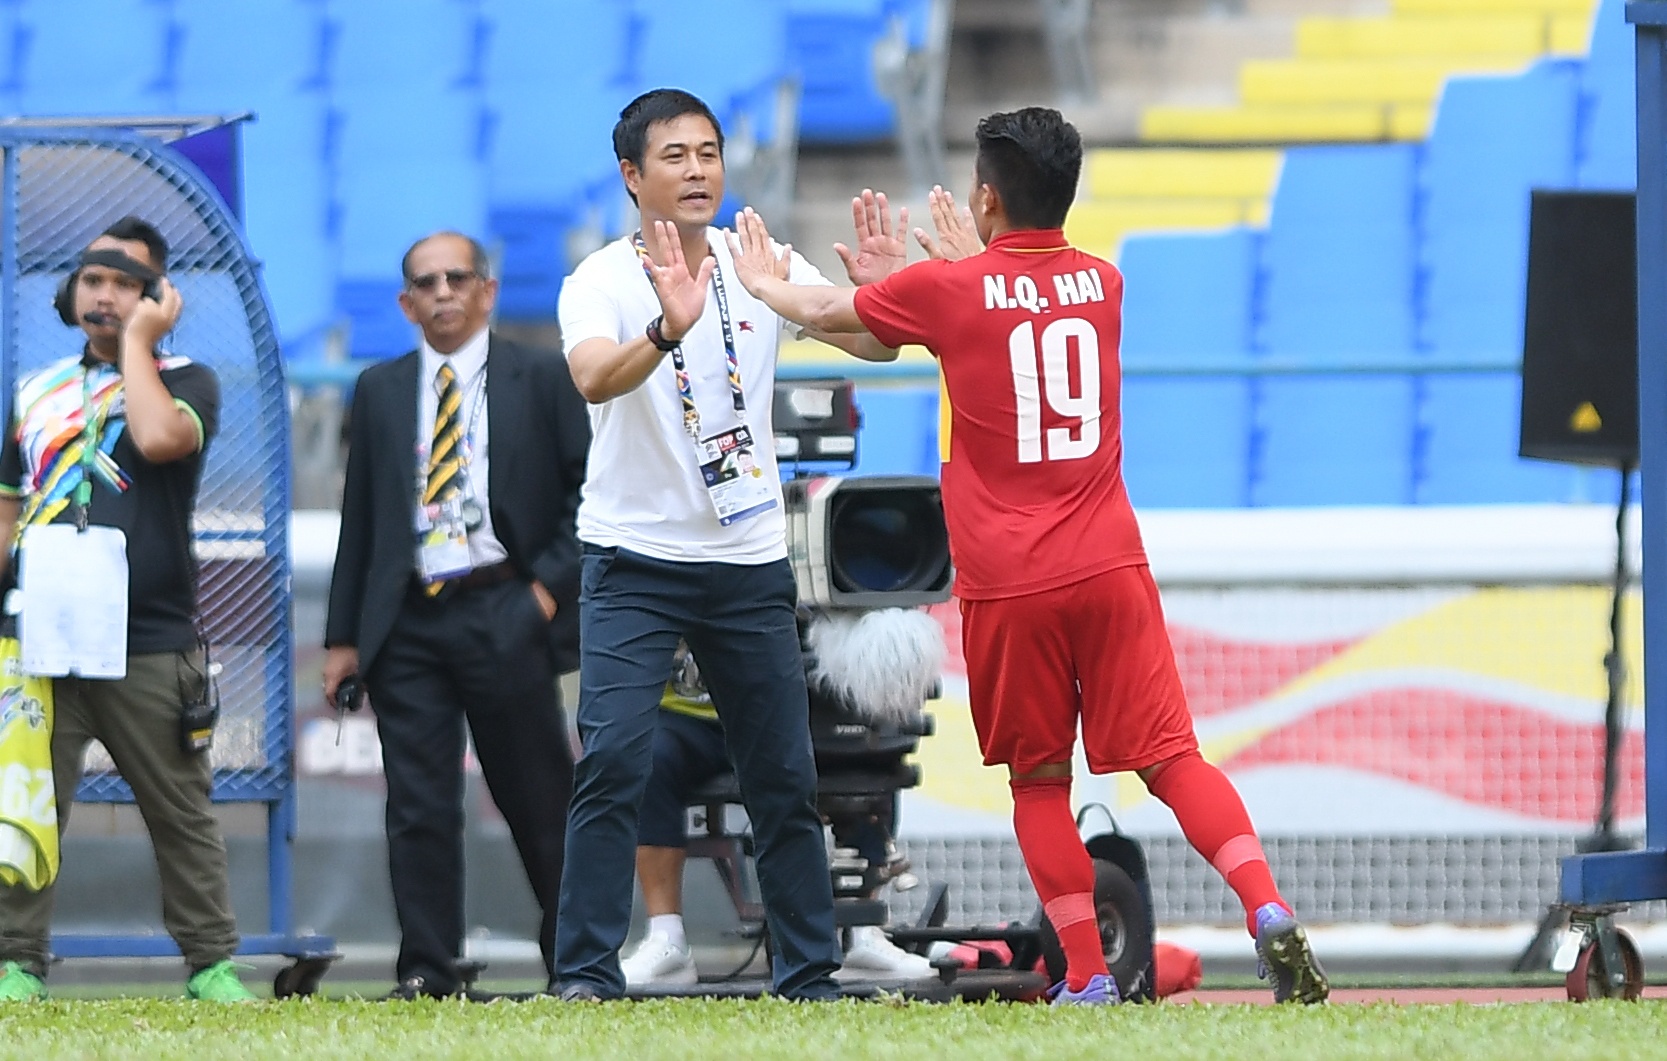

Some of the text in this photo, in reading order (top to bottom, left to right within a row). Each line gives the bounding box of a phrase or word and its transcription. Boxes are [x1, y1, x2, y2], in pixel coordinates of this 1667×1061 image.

[983, 268, 1105, 313] N.Q. HAI
[1008, 317, 1101, 464] 19
